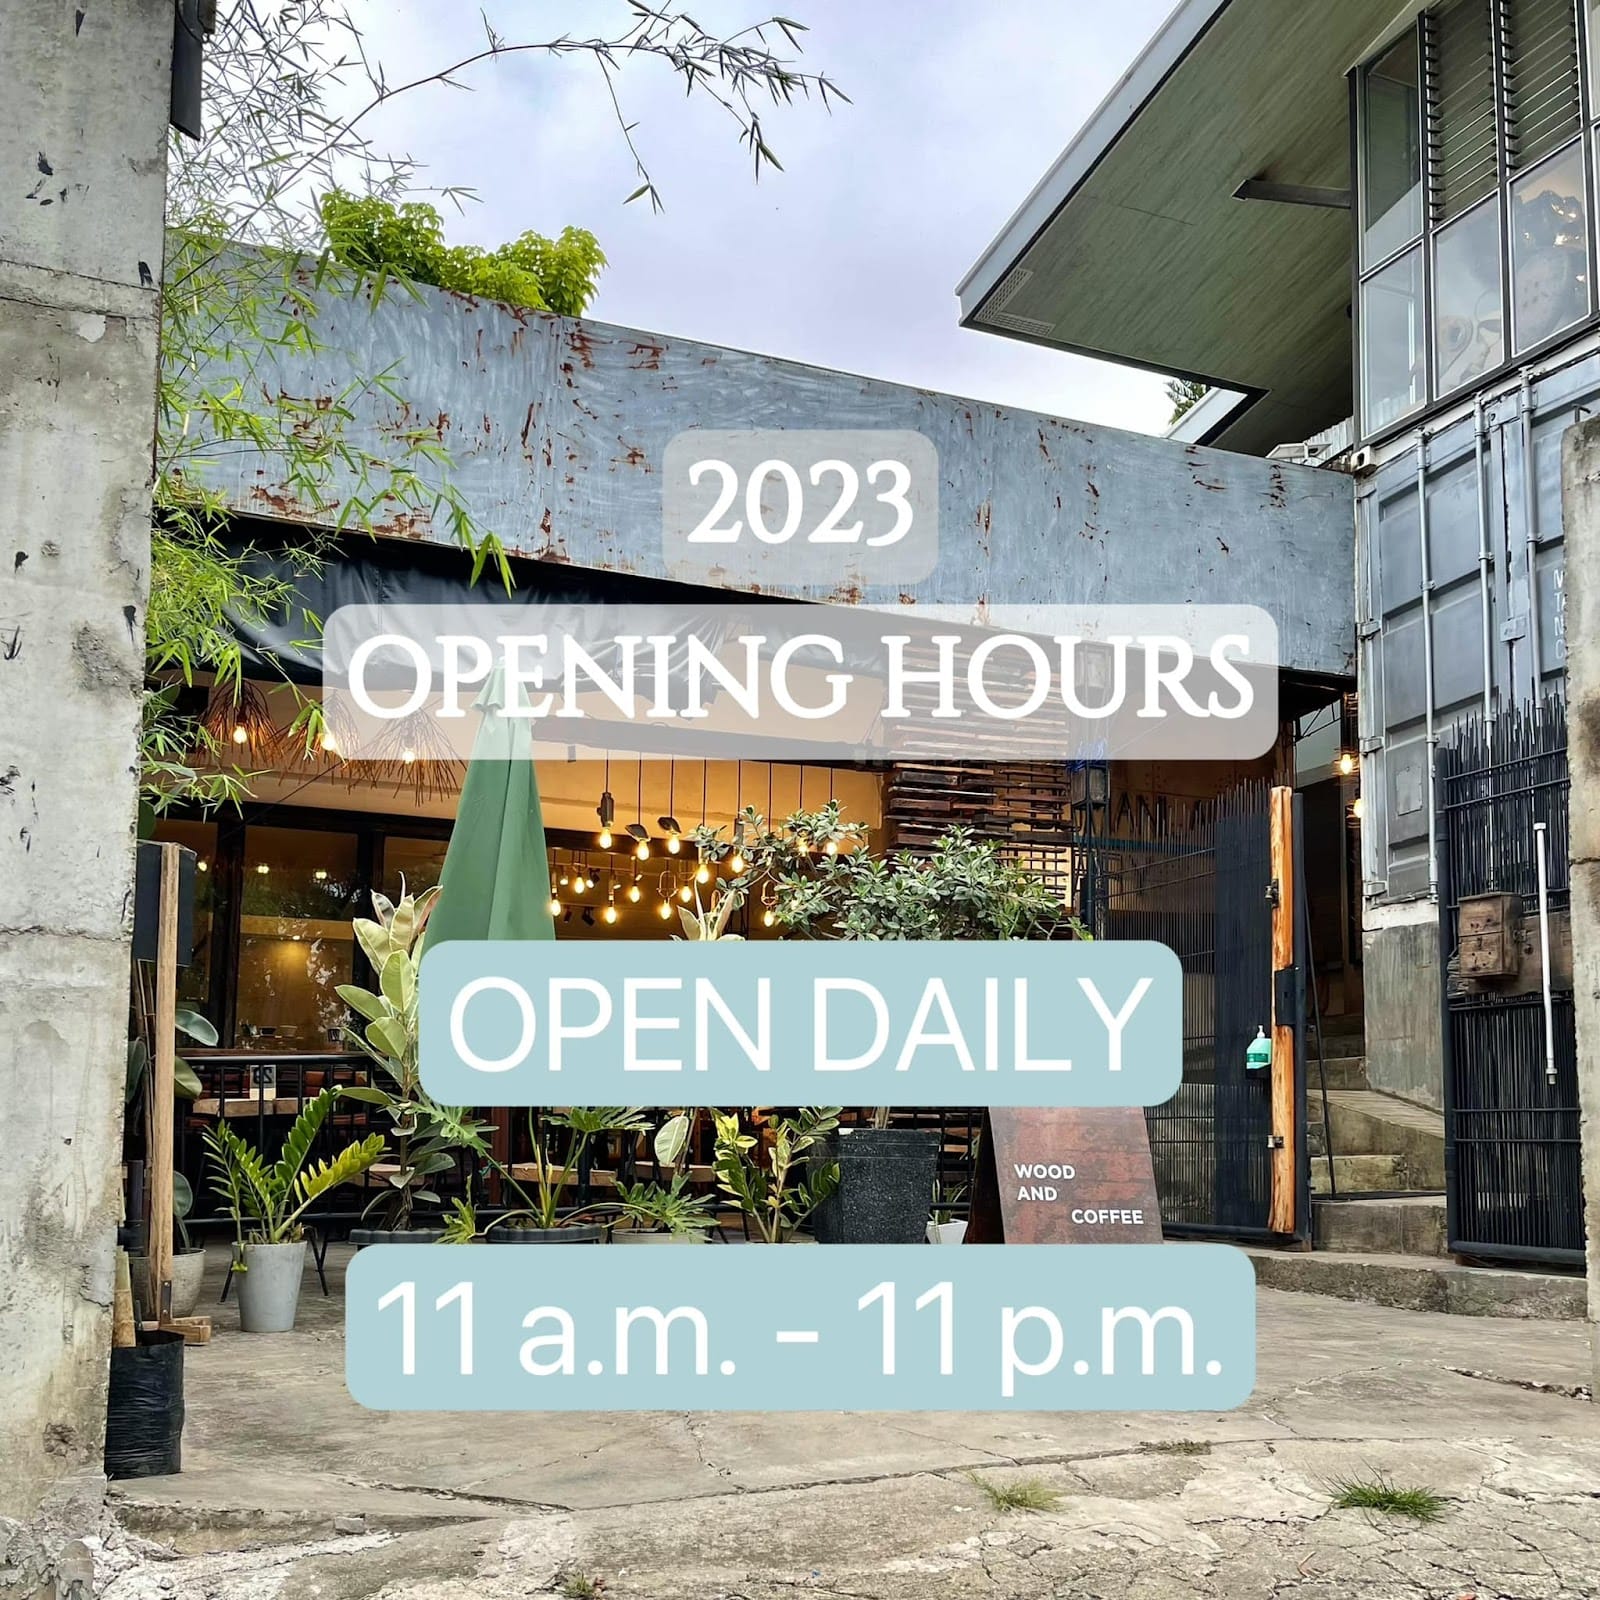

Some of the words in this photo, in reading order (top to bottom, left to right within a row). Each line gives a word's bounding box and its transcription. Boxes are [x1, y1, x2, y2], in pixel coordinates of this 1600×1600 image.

[1014, 1164, 1076, 1180] WOOD
[1017, 1186, 1058, 1201] AND
[1071, 1209, 1145, 1225] COFFEE
